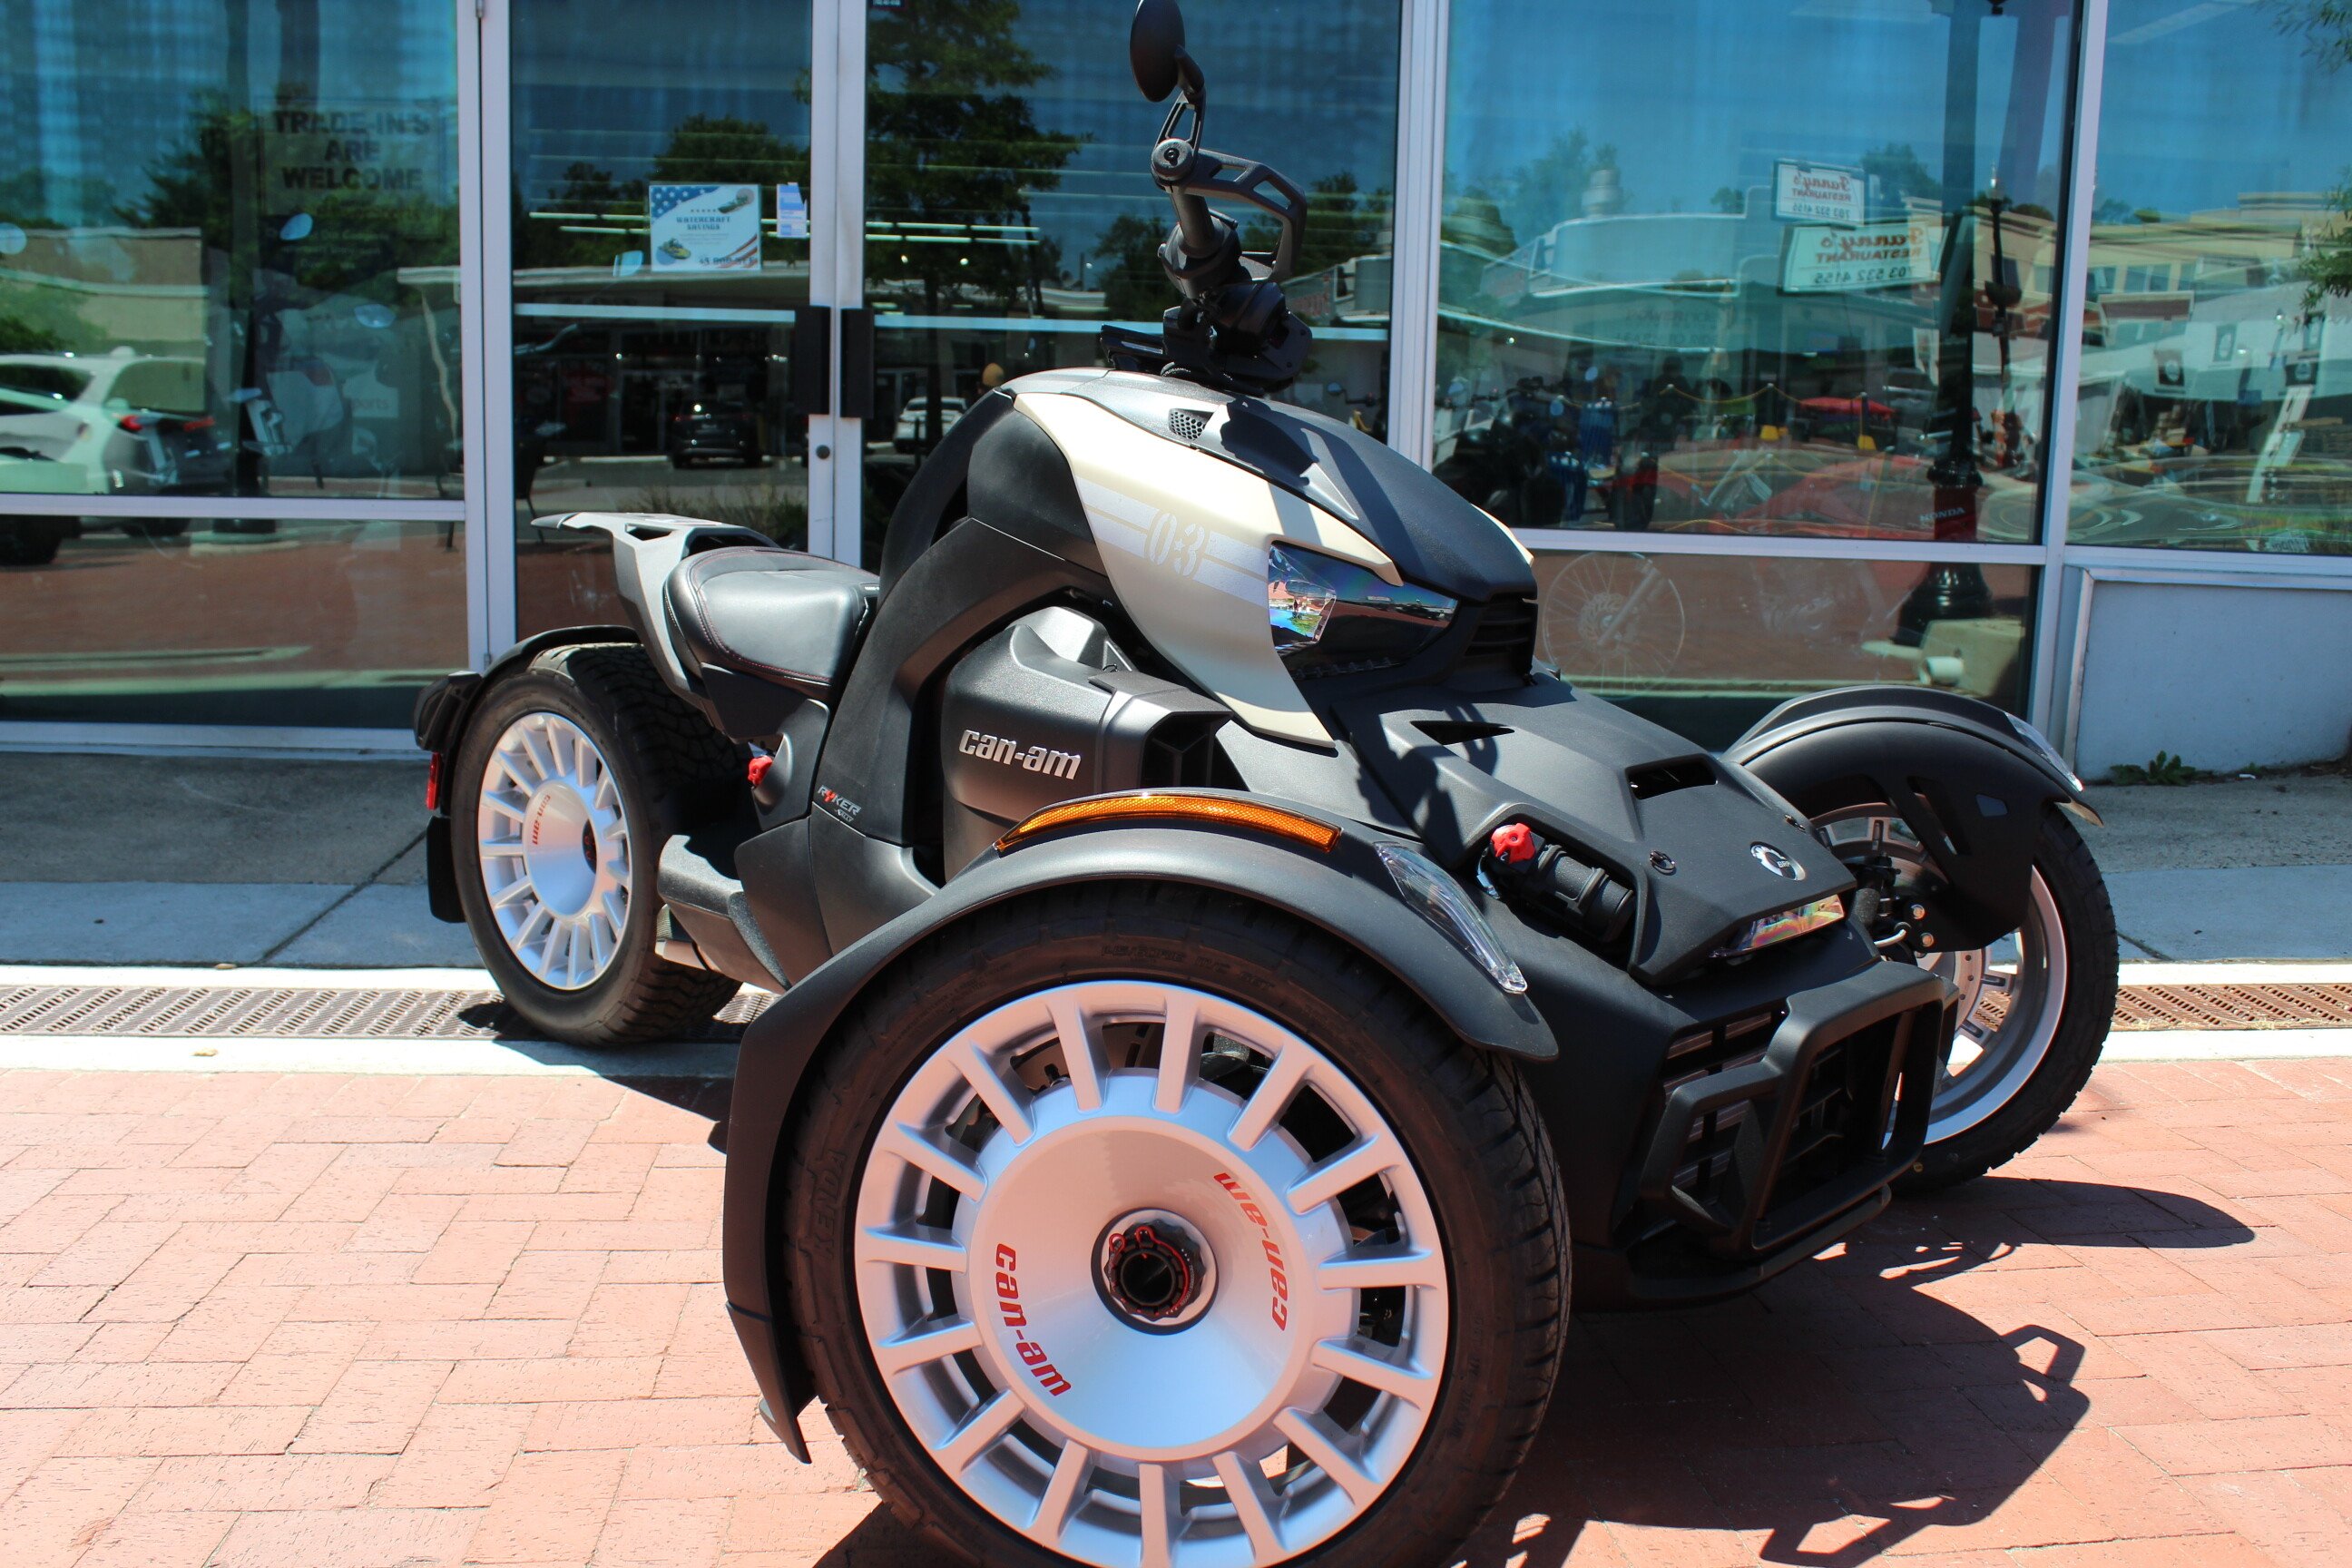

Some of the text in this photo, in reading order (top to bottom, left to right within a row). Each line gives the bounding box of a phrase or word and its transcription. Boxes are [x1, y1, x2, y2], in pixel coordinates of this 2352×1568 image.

[275, 111, 430, 134] TRADE-INS
[325, 140, 379, 162] ARE
[282, 168, 422, 189] WELCOME
[1917, 506, 1966, 523] HONDA
[958, 729, 1082, 780] can-am
[817, 784, 862, 816] RYKER
[532, 794, 552, 846] can-am
[1213, 1172, 1289, 1332] can-am
[995, 1243, 1072, 1396] can-am
